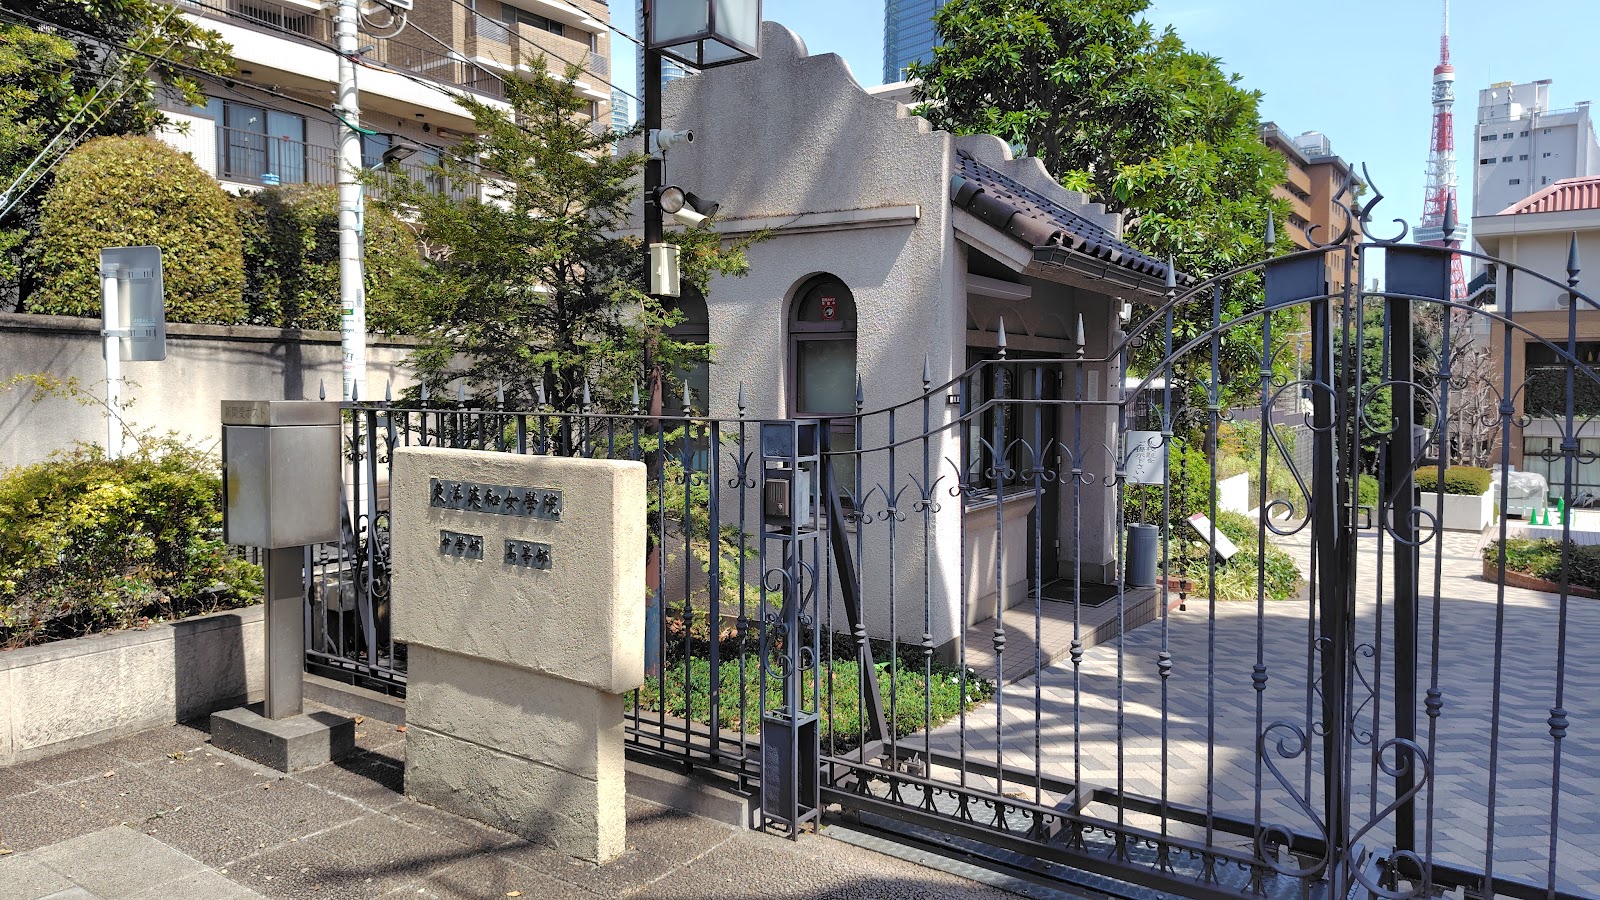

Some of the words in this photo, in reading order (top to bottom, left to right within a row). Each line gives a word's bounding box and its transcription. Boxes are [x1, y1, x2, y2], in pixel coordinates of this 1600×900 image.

[433, 480, 562, 517] 東洋英和女學院
[506, 542, 549, 566] 高等部
